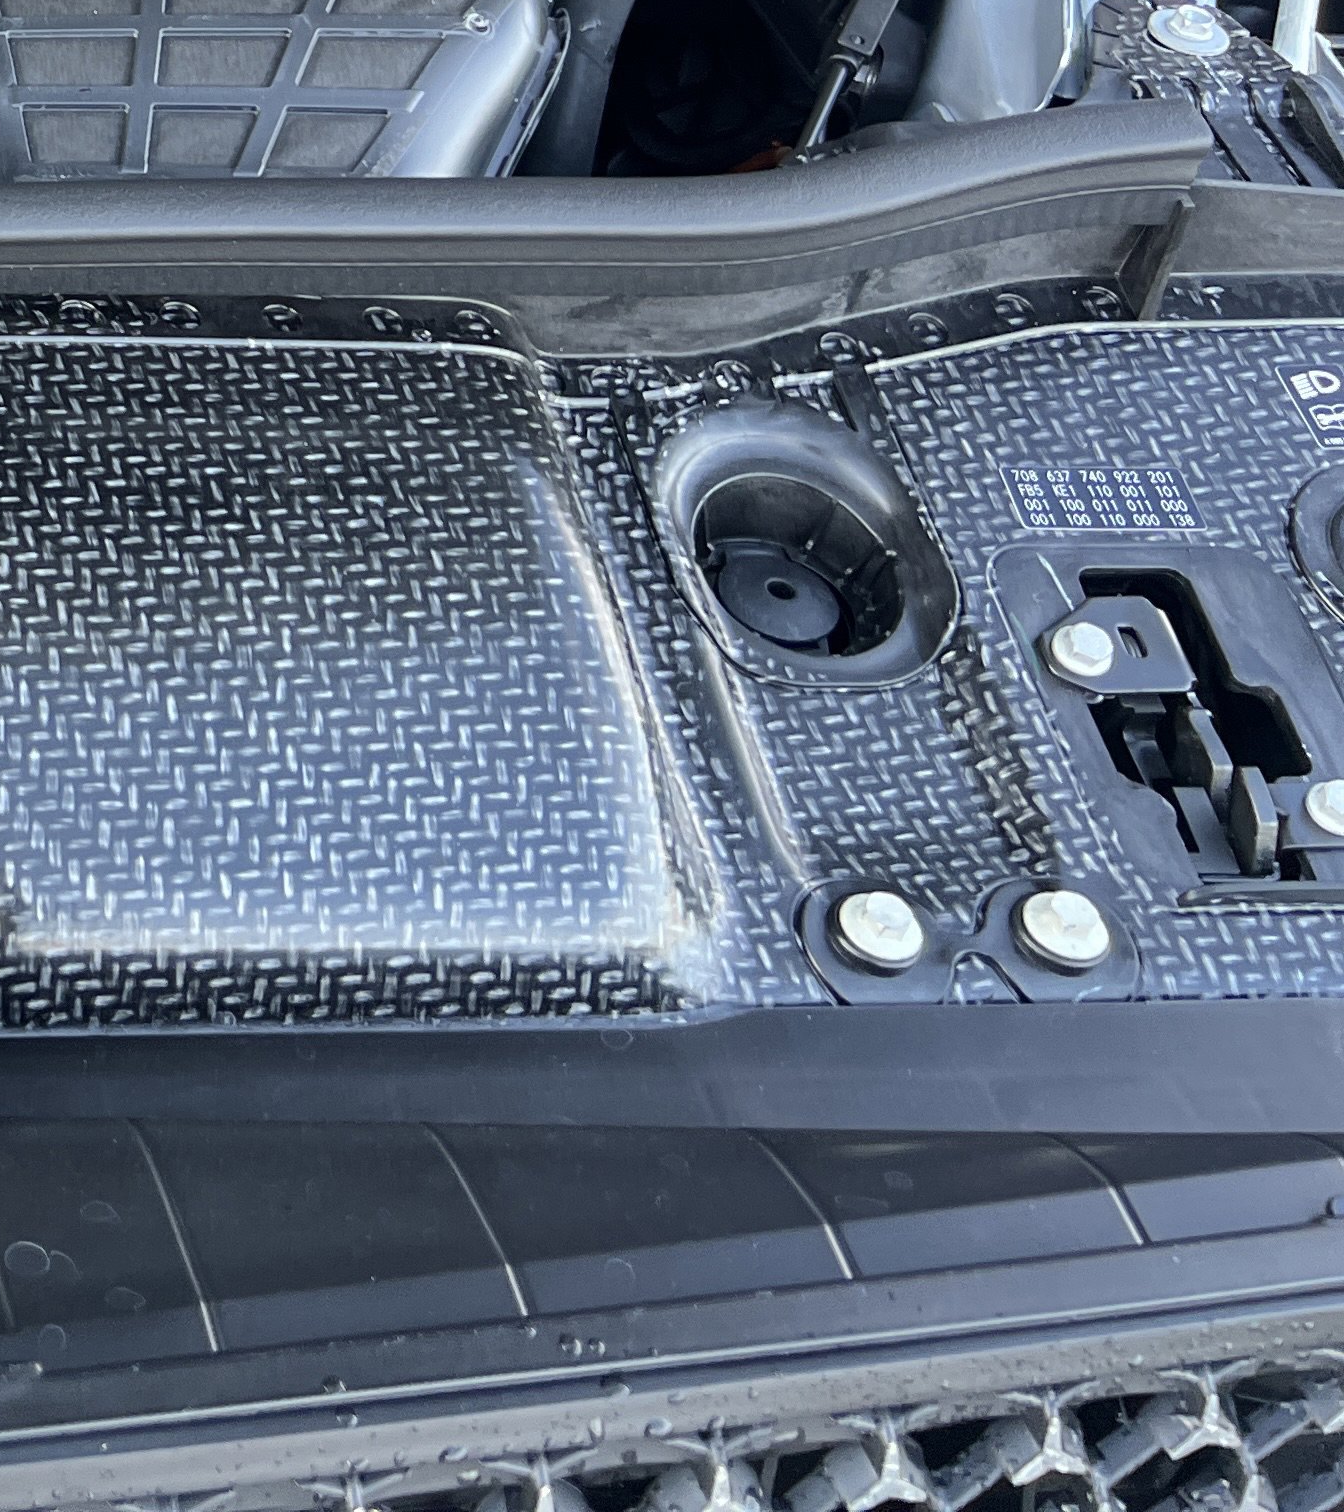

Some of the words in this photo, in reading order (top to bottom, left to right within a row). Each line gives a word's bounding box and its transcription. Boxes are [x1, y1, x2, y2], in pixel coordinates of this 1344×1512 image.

[1011, 470, 1039, 482] 708
[1047, 470, 1070, 483] 637
[1078, 470, 1106, 483] 740
[1113, 471, 1140, 483] 922
[1147, 471, 1174, 483] 201
[1017, 485, 1044, 497] FB5
[1053, 485, 1076, 497] KE1
[1087, 485, 1113, 498] 110
[1120, 485, 1146, 498] 001
[1155, 485, 1181, 498] 101
[1024, 499, 1050, 511] 001
[1059, 499, 1085, 511] 100
[1092, 499, 1118, 512] 011
[1126, 499, 1153, 512] 011
[1161, 499, 1188, 512] 000
[1030, 513, 1056, 526] 001
[1066, 513, 1092, 526] 100
[1100, 513, 1126, 526] 110
[1133, 513, 1160, 526] 000
[1169, 513, 1195, 527] 138
